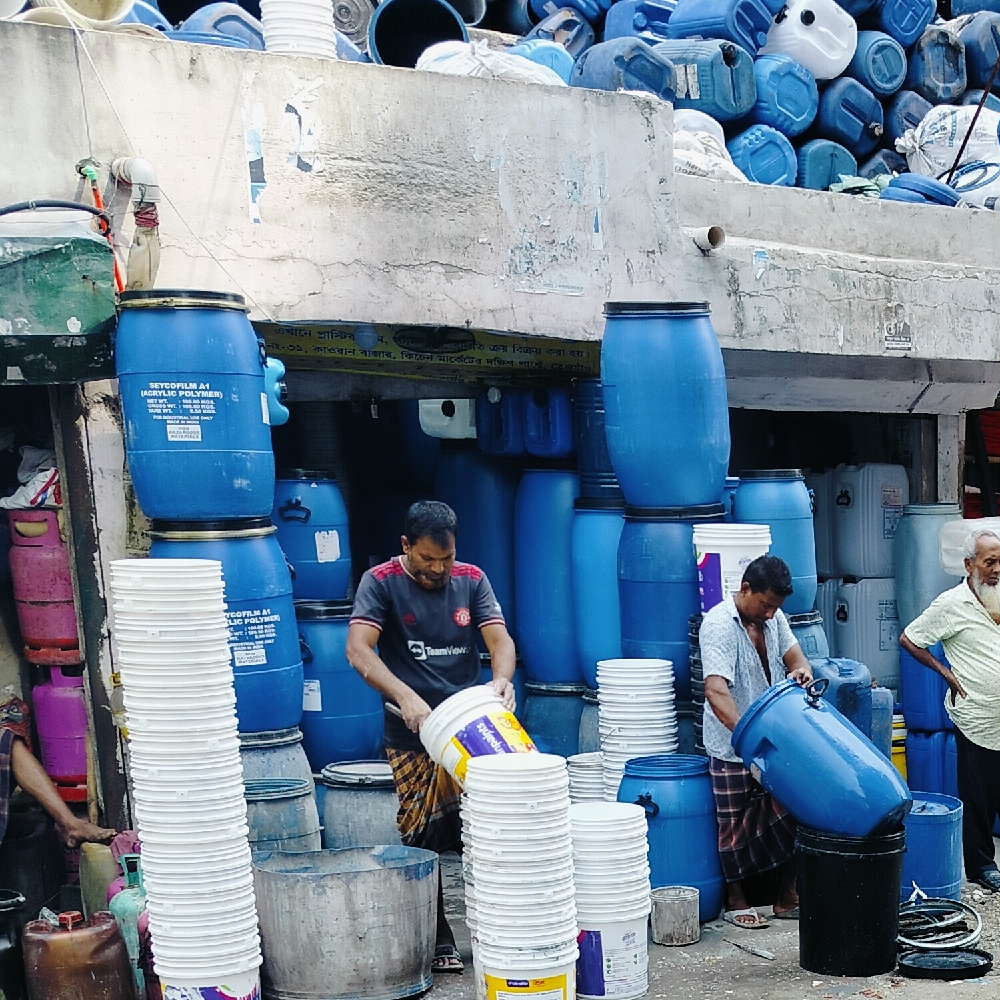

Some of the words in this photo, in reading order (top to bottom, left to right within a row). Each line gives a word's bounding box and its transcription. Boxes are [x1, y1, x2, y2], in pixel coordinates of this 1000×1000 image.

[274, 327, 312, 337] এখানে
[312, 346, 356, 356] কাওরান
[401, 350, 434, 363] কিচেন
[437, 354, 482, 364] মার্কেটের
[546, 349, 565, 357] করা
[149, 382, 197, 390] SEYCOFILM
[199, 382, 210, 390] A1
[140, 389, 177, 398] (ACRYLIC
[178, 390, 223, 399] POLYMER)
[244, 614, 280, 624] POLYMER)
